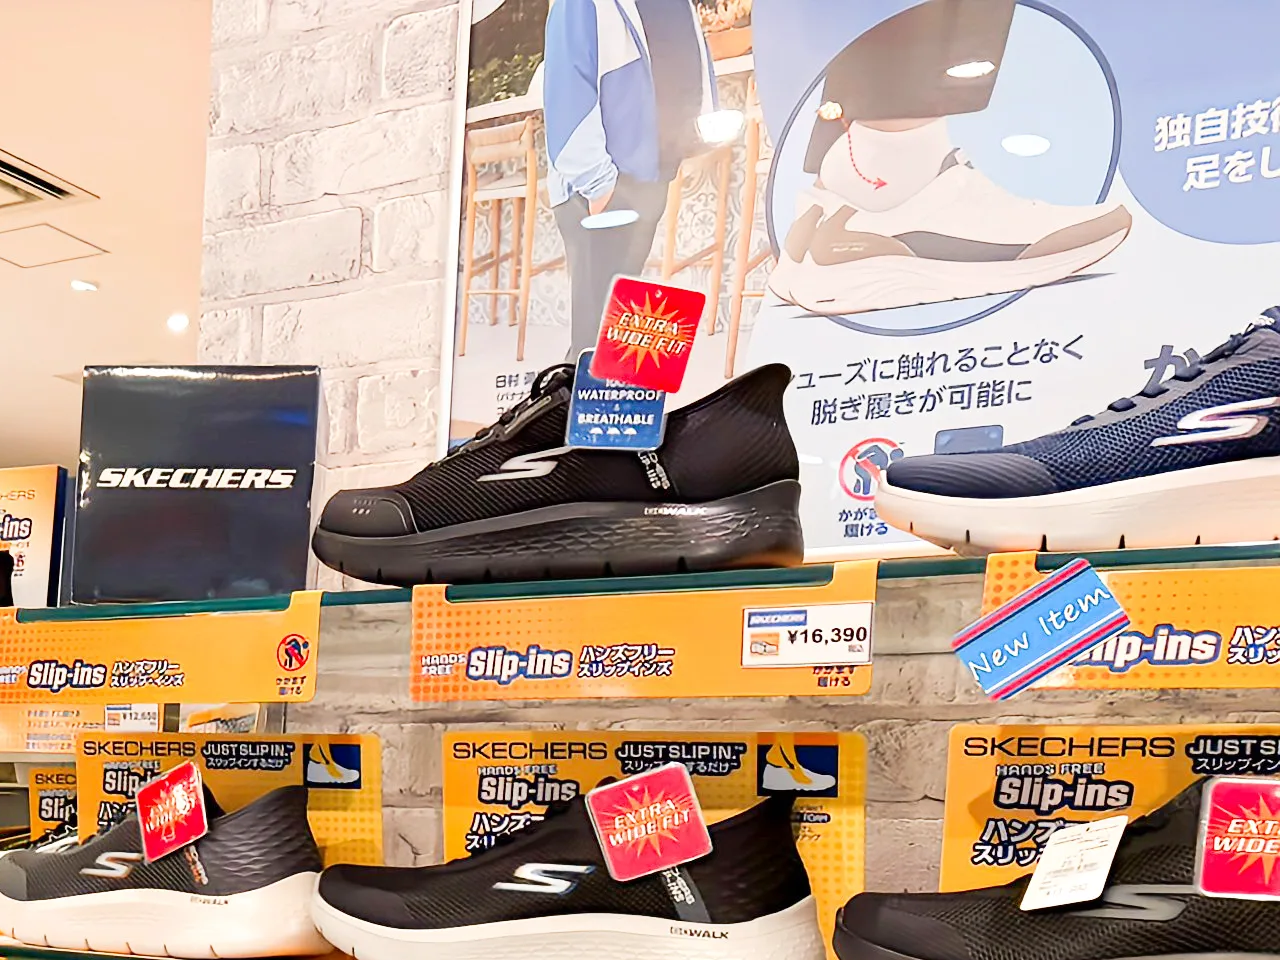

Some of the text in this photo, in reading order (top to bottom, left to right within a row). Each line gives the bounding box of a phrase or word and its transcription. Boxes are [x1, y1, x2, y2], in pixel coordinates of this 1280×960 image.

[619, 312, 679, 335] EXTRA
[606, 326, 686, 356] WIDE FIT
[791, 334, 1086, 392] ューズに触れることなく
[578, 389, 664, 401] WATERPROOF
[811, 379, 1032, 426] 脱ぎ履きが可能に
[578, 413, 654, 427] BREATHABLE
[97, 468, 297, 489] SKECHERS
[787, 626, 867, 644] ¥16,390
[968, 586, 1110, 681] New Item
[421, 655, 466, 665] HANDS
[579, 643, 675, 662] ハンズフリー
[111, 659, 179, 673] ハンズフリー
[421, 665, 454, 676] FREE
[466, 645, 573, 684] Slip-ins
[576, 659, 672, 677] スリップインズ
[27, 659, 108, 692] Slip-ins
[83, 741, 268, 757] SKECHERS JUST SLIP
[453, 742, 710, 760] SKECHERS JUST SLIP
[963, 737, 1255, 758] SKECHERS JUST
[996, 763, 1105, 776] HANDS FREE
[479, 775, 580, 809] Slip-ins
[994, 776, 1134, 815] Slip-ins
[613, 799, 677, 830] EXTRA
[608, 809, 691, 847] WIDE FIT
[1228, 818, 1280, 835] EXT
